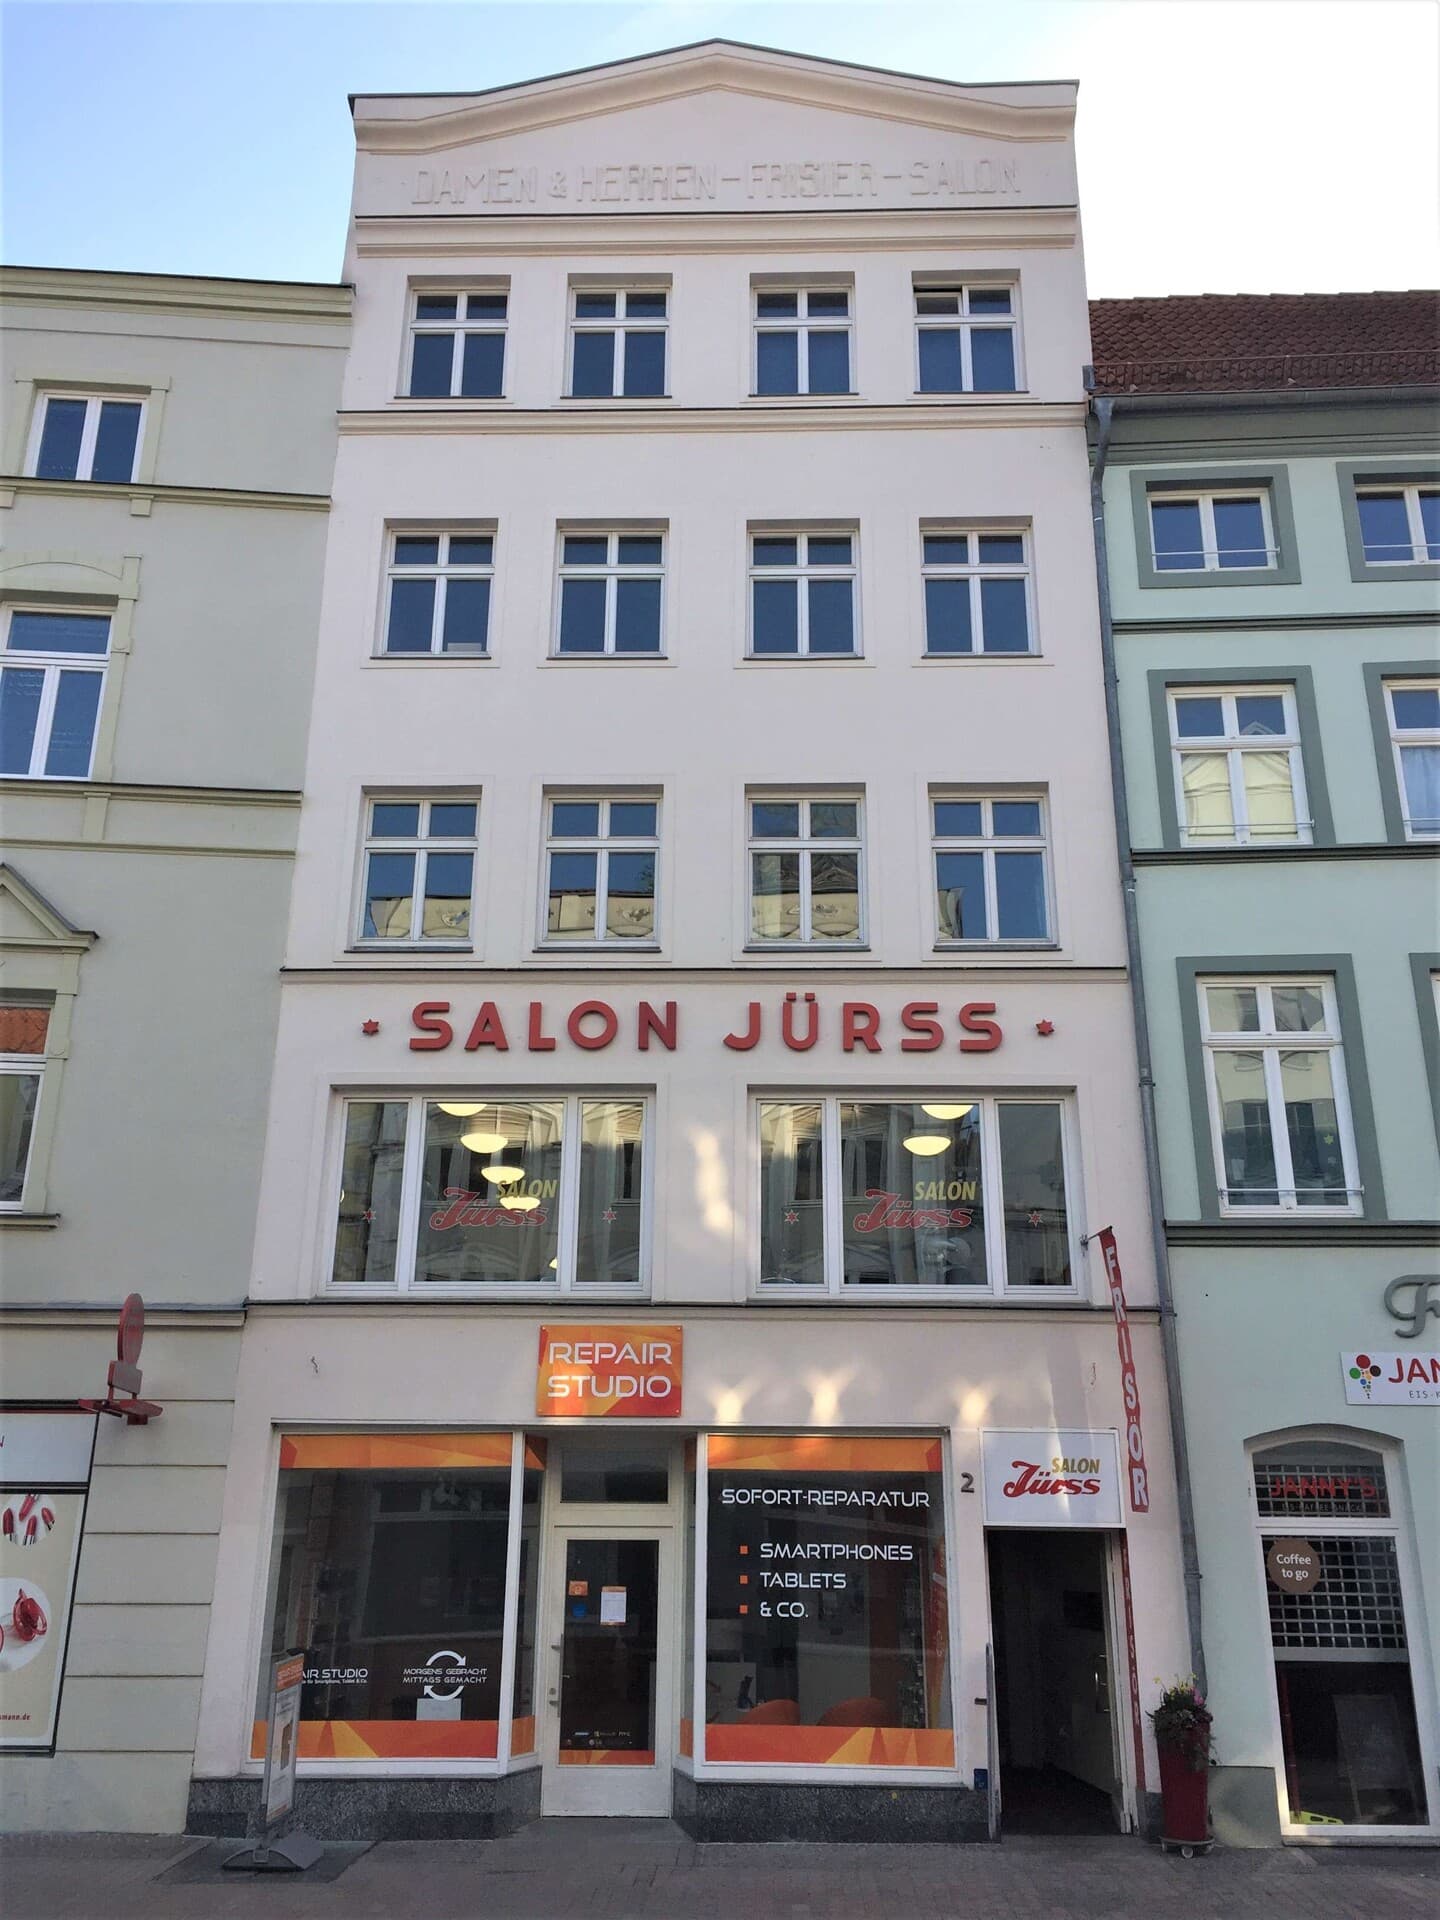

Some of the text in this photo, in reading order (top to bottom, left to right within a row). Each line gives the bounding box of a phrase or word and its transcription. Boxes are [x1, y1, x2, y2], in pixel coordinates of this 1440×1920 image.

[411, 167, 537, 204] DAMEN
[548, 170, 568, 199] &
[409, 992, 1002, 1051] SALON JÜRSS
[496, 1180, 557, 1199] SALON
[914, 1180, 977, 1201] SALON
[548, 1342, 672, 1364] REPAIR
[1104, 1245, 1149, 1507] FRISÖR
[547, 1375, 672, 1398] STUDIO
[1051, 1458, 1100, 1474] SALON
[960, 1472, 975, 1493] 2
[1270, 1475, 1376, 1497] JANNY'S
[721, 1488, 930, 1508] SOFORT-REPARATUR
[760, 1542, 913, 1561] SMARTPHONES
[1276, 1554, 1312, 1565] Coffee
[760, 1572, 847, 1589] TABLETS
[1281, 1568, 1309, 1581] to go
[760, 1602, 809, 1618] & CO.
[321, 1668, 369, 1678] STUDIO
